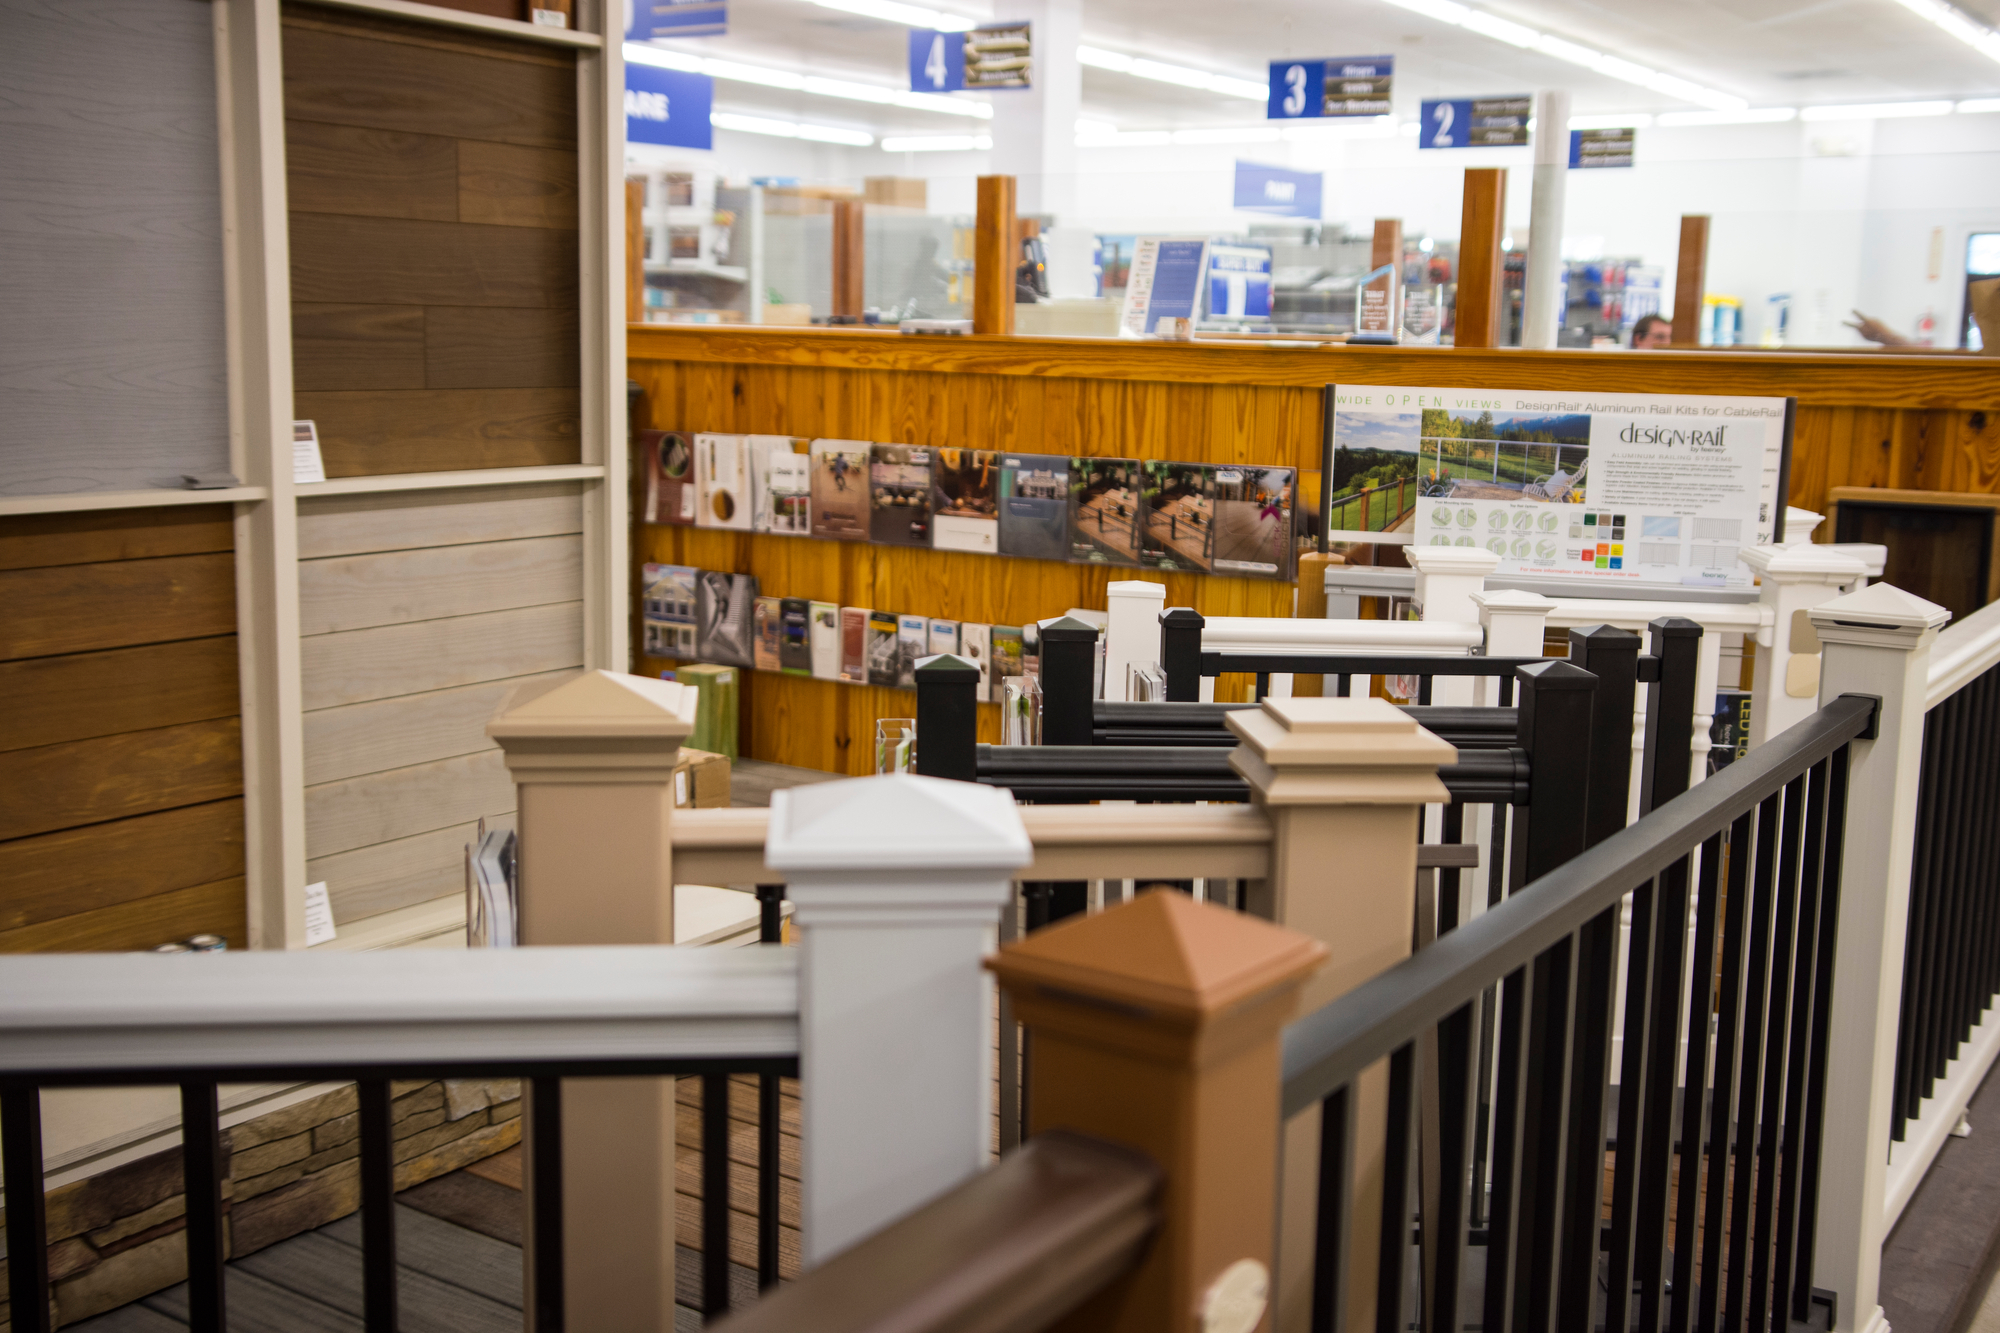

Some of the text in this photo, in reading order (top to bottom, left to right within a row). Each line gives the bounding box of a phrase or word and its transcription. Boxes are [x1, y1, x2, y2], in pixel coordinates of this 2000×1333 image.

[924, 34, 948, 89] 4
[623, 89, 670, 122] ARE
[1283, 64, 1307, 117] 3
[1432, 102, 1455, 147] 2
[1336, 394, 1502, 409] WIDE OPEN VIEWS
[1586, 403, 1646, 414] Aluminum
[1650, 404, 1672, 414] Rail
[1676, 405, 1699, 415] Kits
[1703, 406, 1720, 416] for
[1724, 407, 1783, 418] CableRail
[1700, 446, 1727, 454] feeney
[1702, 572, 1729, 580] feeney
[1740, 700, 1751, 731] LED
